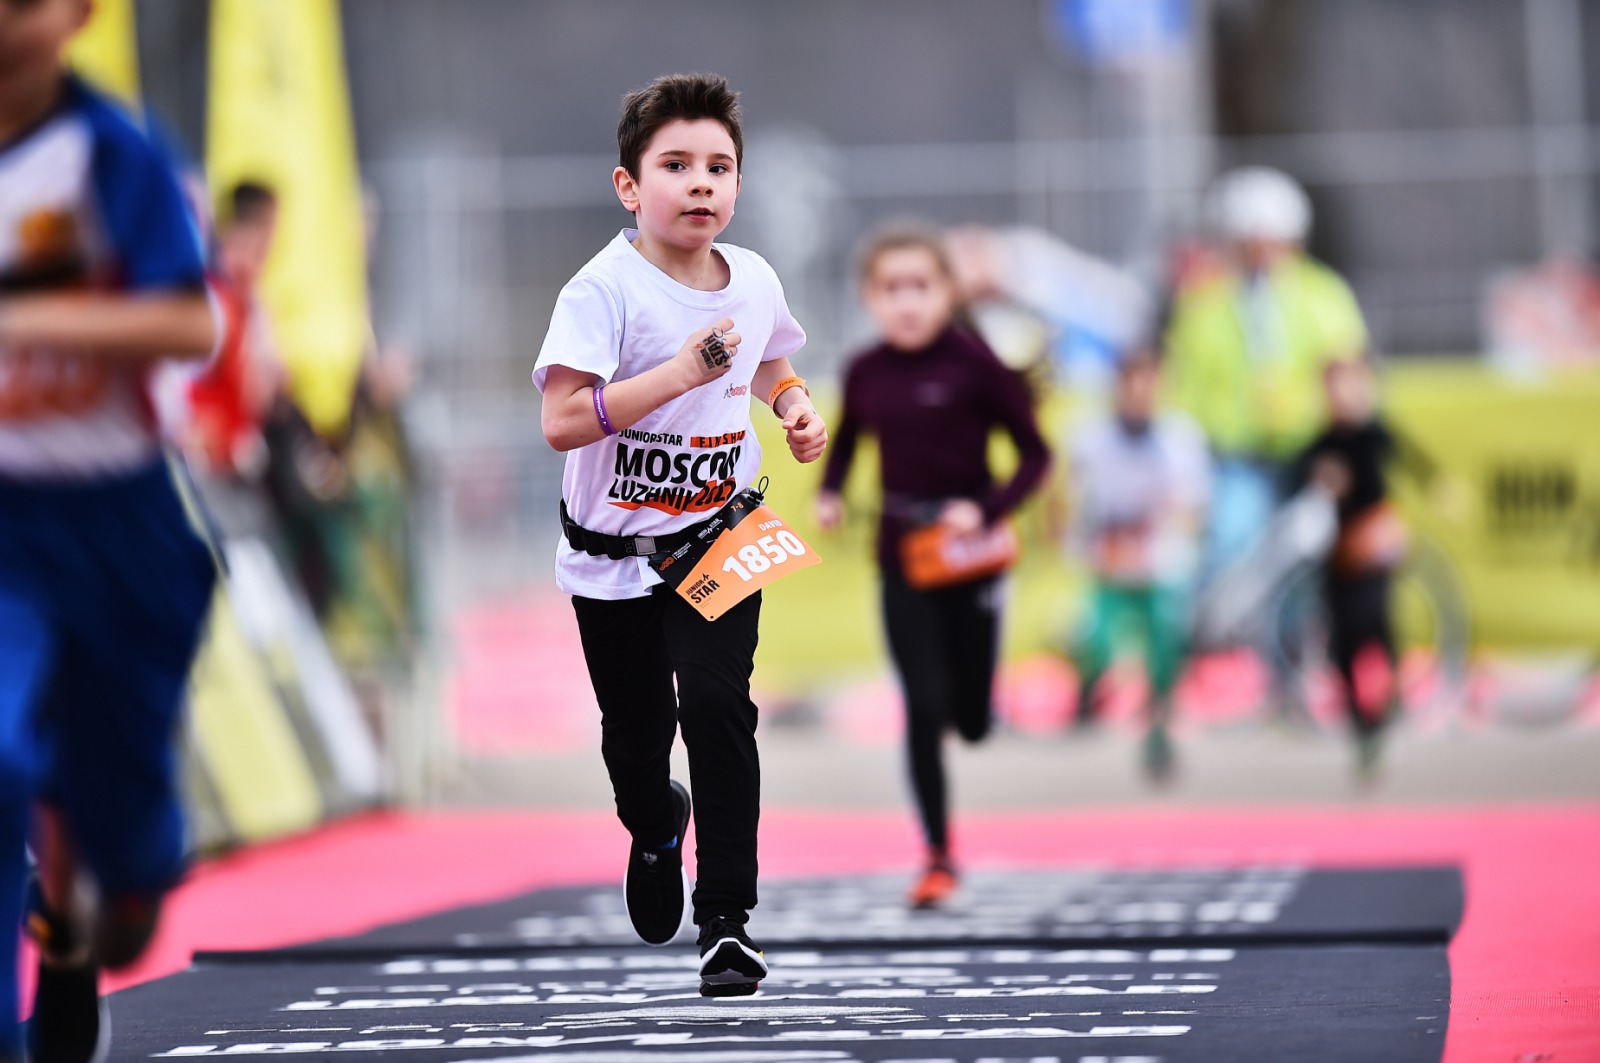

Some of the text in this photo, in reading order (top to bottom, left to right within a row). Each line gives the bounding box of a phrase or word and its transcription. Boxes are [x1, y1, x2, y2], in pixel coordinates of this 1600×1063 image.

[703, 334, 728, 366] STAR
[758, 519, 783, 531] DAVID
[722, 530, 806, 582] 1850
[686, 579, 705, 595] JUNIOR
[690, 579, 720, 604] STAR
